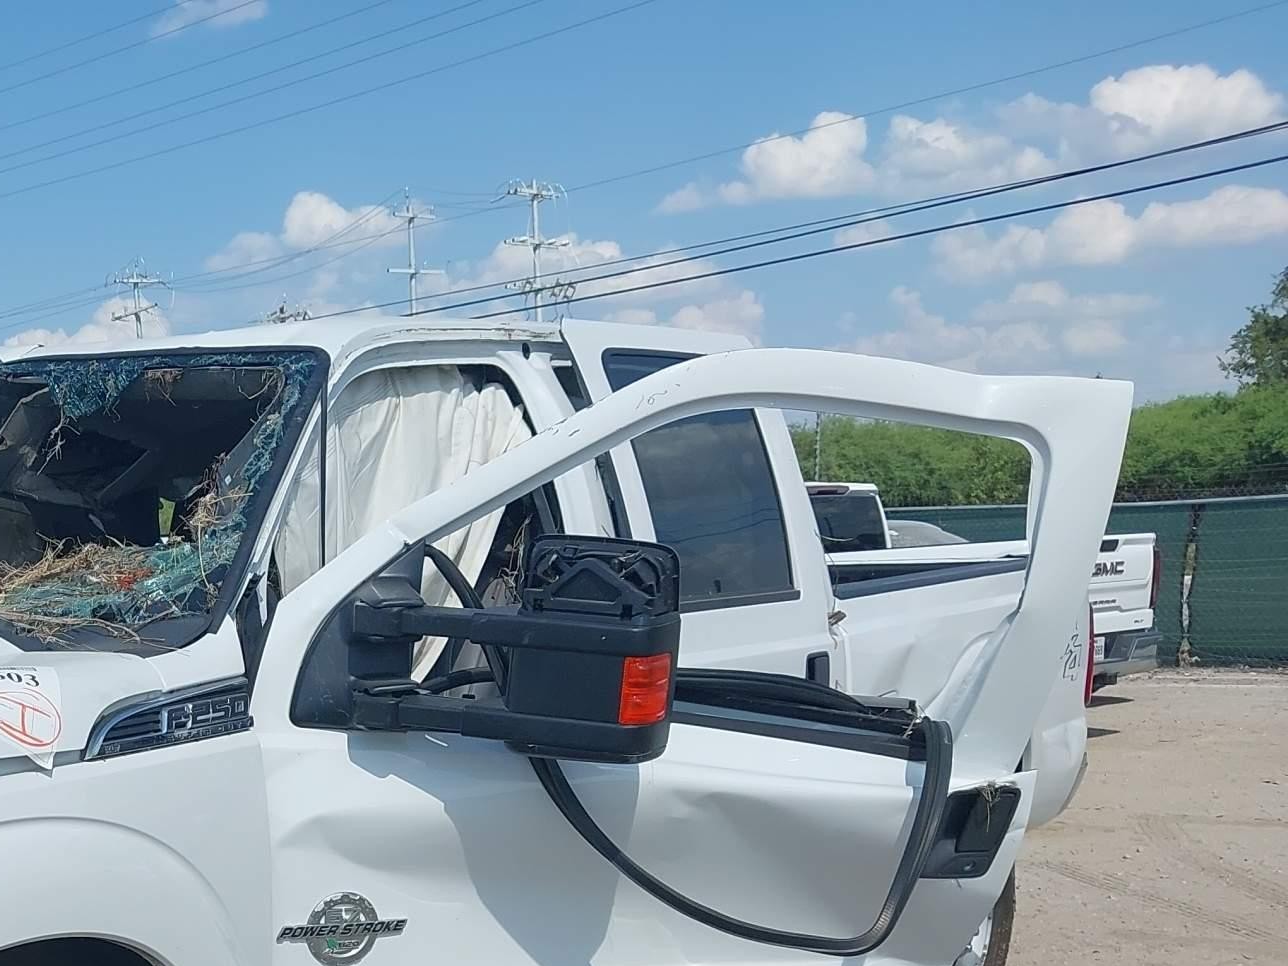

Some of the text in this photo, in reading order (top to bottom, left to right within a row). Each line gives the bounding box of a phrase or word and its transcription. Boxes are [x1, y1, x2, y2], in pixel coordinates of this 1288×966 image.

[1092, 561, 1124, 577] GMC
[280, 919, 407, 938] POWER STROKE
